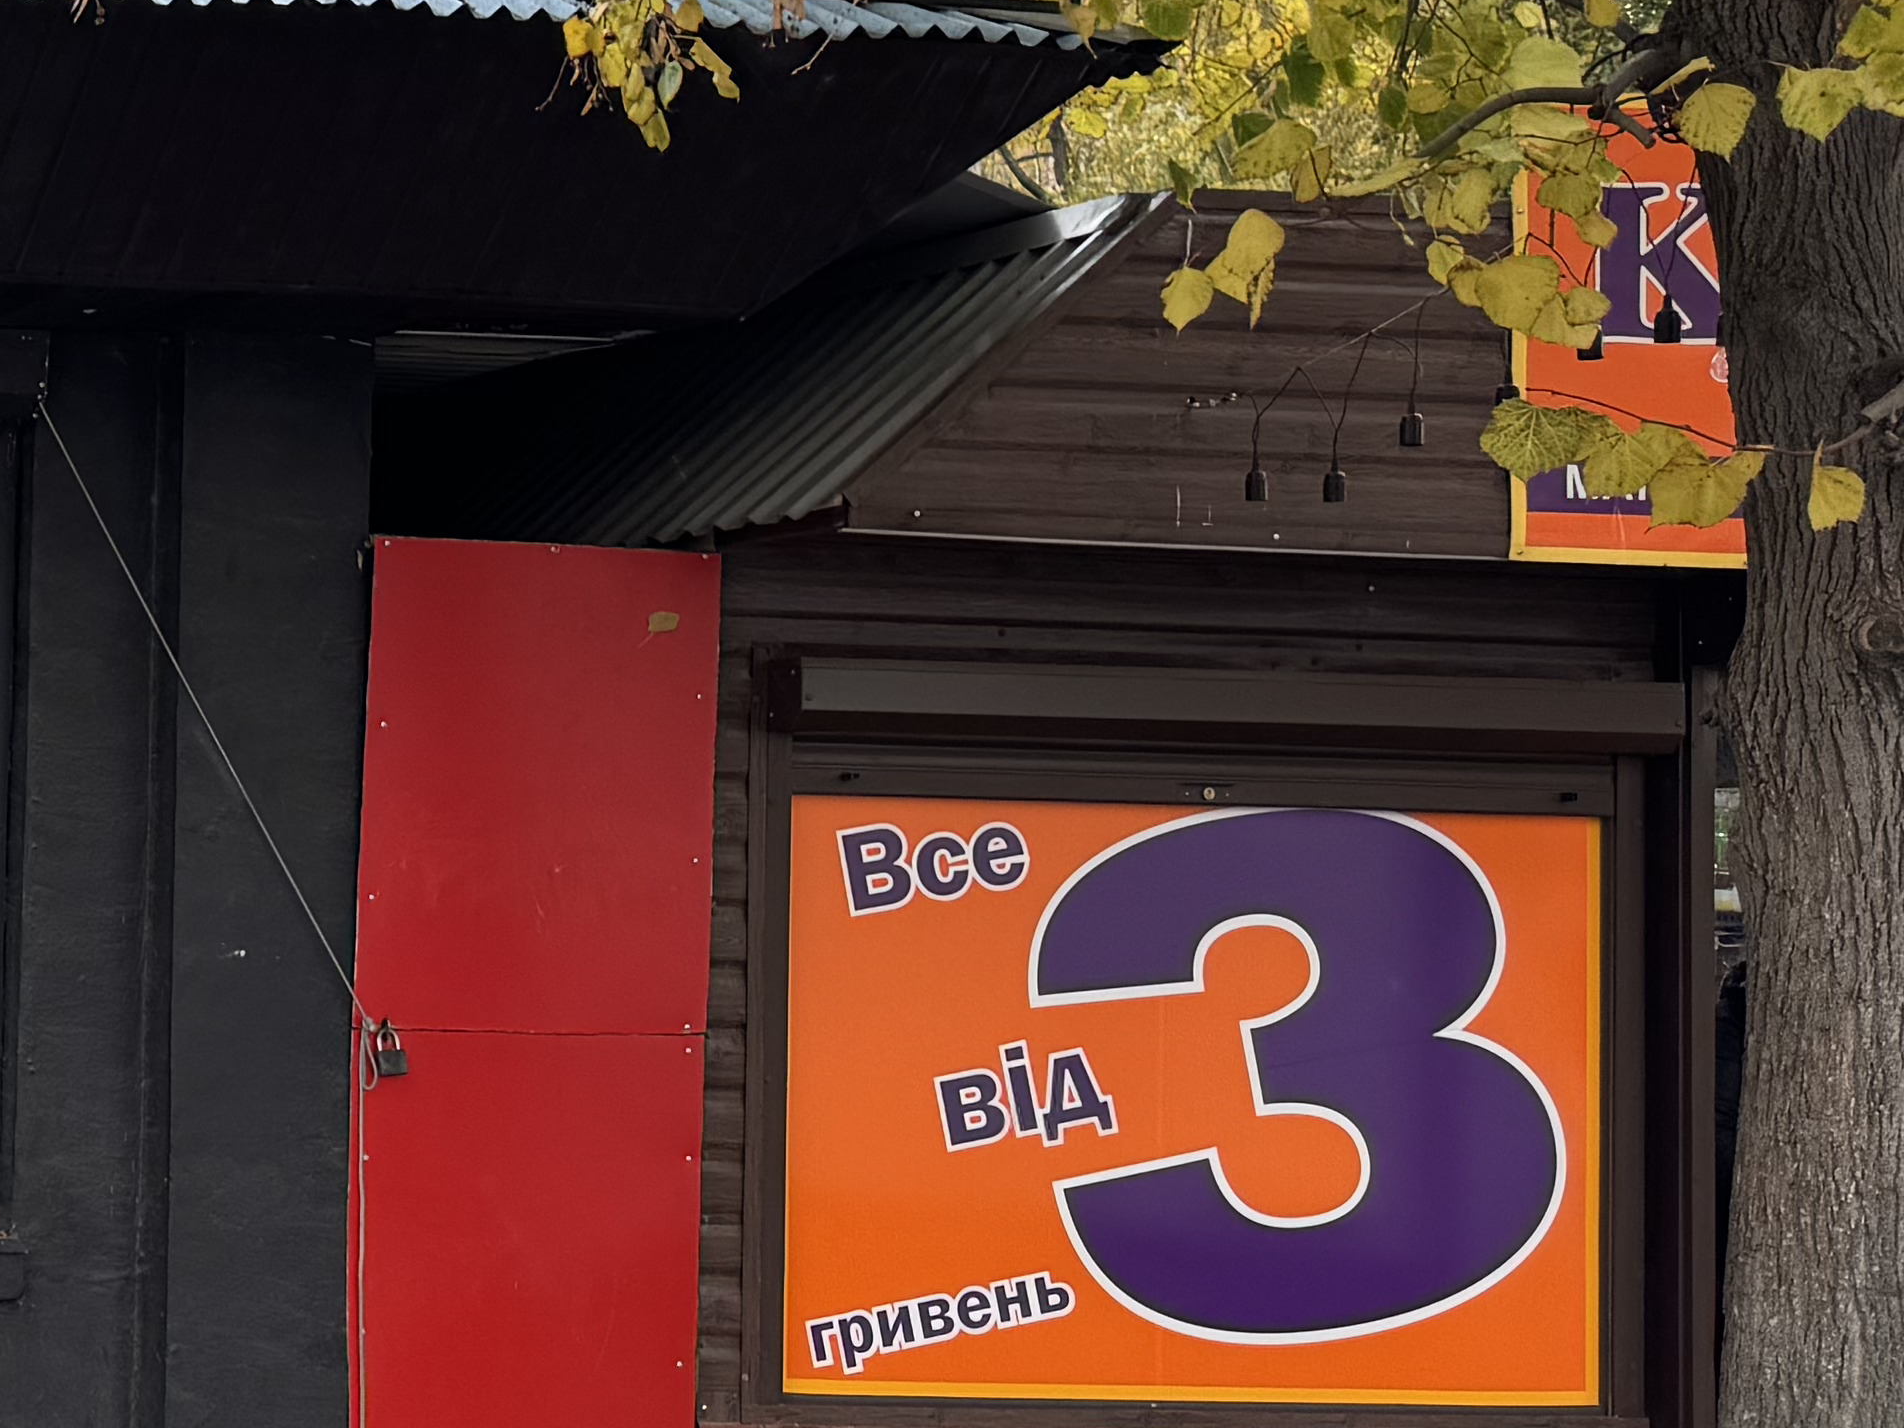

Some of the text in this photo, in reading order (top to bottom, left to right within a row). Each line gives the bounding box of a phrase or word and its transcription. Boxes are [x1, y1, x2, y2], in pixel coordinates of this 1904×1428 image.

[837, 820, 1030, 917] Все
[934, 805, 1567, 1345] від 3
[805, 1269, 1076, 1375] гривень
